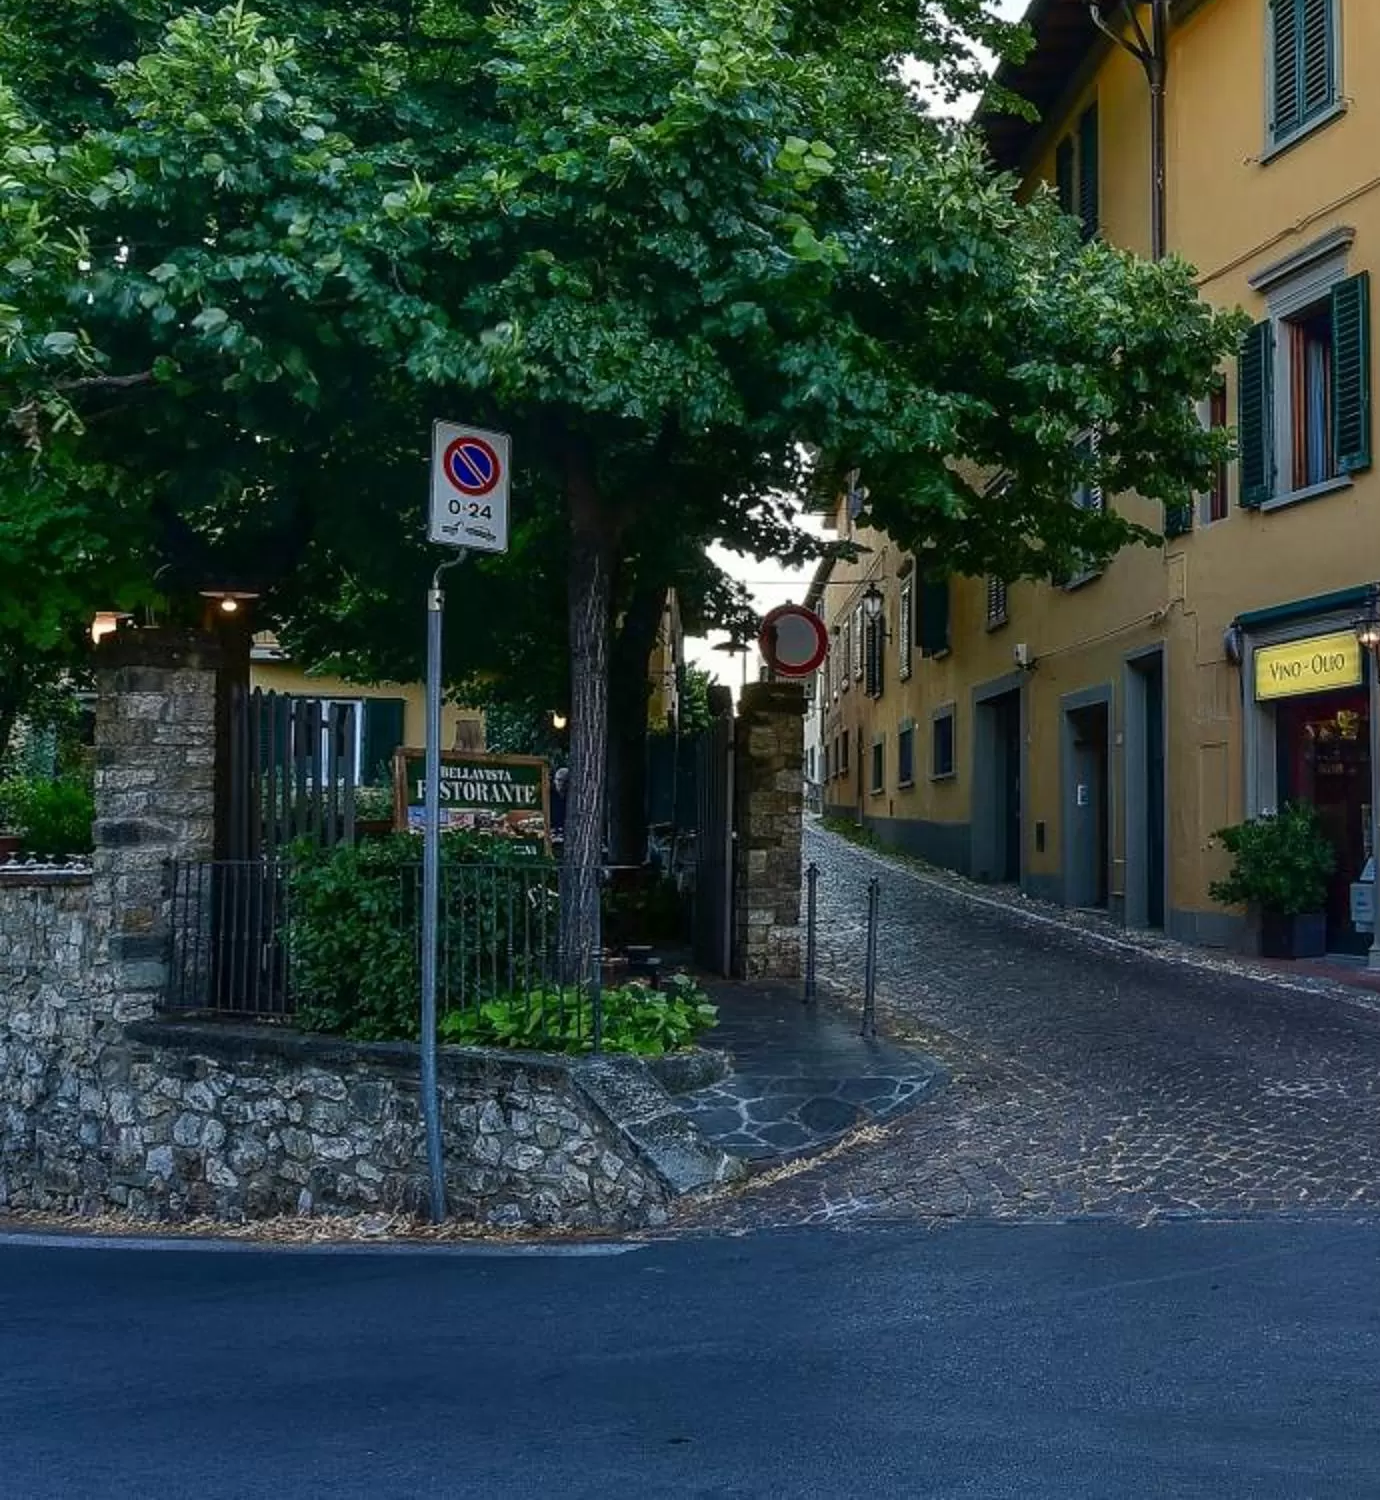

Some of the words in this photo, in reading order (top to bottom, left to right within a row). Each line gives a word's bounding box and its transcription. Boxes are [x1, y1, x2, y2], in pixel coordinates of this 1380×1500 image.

[448, 499, 492, 520] 0-24
[439, 765, 513, 782] BELLAVISTA
[416, 779, 537, 805] RSTORANTE
